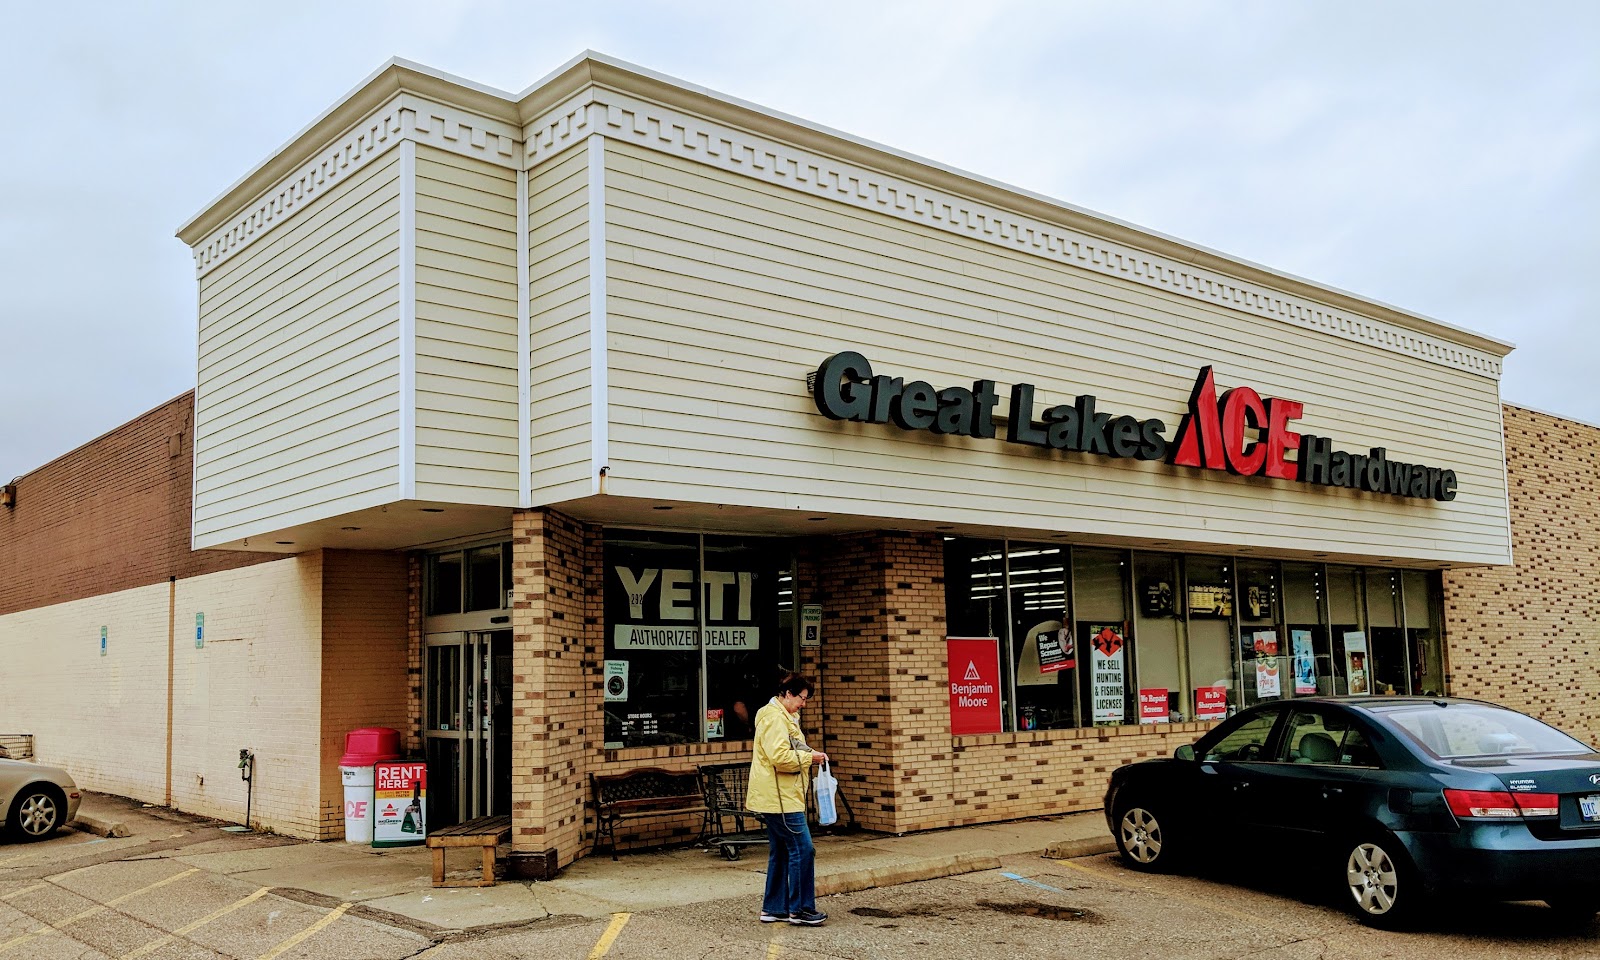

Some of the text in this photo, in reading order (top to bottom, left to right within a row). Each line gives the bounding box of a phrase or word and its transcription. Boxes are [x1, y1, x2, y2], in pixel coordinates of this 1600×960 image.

[815, 351, 1458, 501] Great Lakes ACE Hardware
[614, 566, 752, 621] YETI
[629, 629, 747, 646] AUTHORIZED DEALER
[1039, 640, 1058, 650] Repair
[1040, 648, 1062, 658] Screens
[1097, 660, 1120, 670] WE SELL
[1096, 672, 1122, 683] HUNTING
[951, 682, 993, 696] Benjamin
[1095, 686, 1124, 696] & FISHING
[958, 696, 988, 708] Moore
[1096, 698, 1122, 710] LICENSES
[1140, 694, 1167, 704] We Repair
[1144, 705, 1164, 713] Screens
[1198, 700, 1226, 709] Sharpening
[378, 766, 424, 780] RENT
[378, 780, 408, 788] HERE
